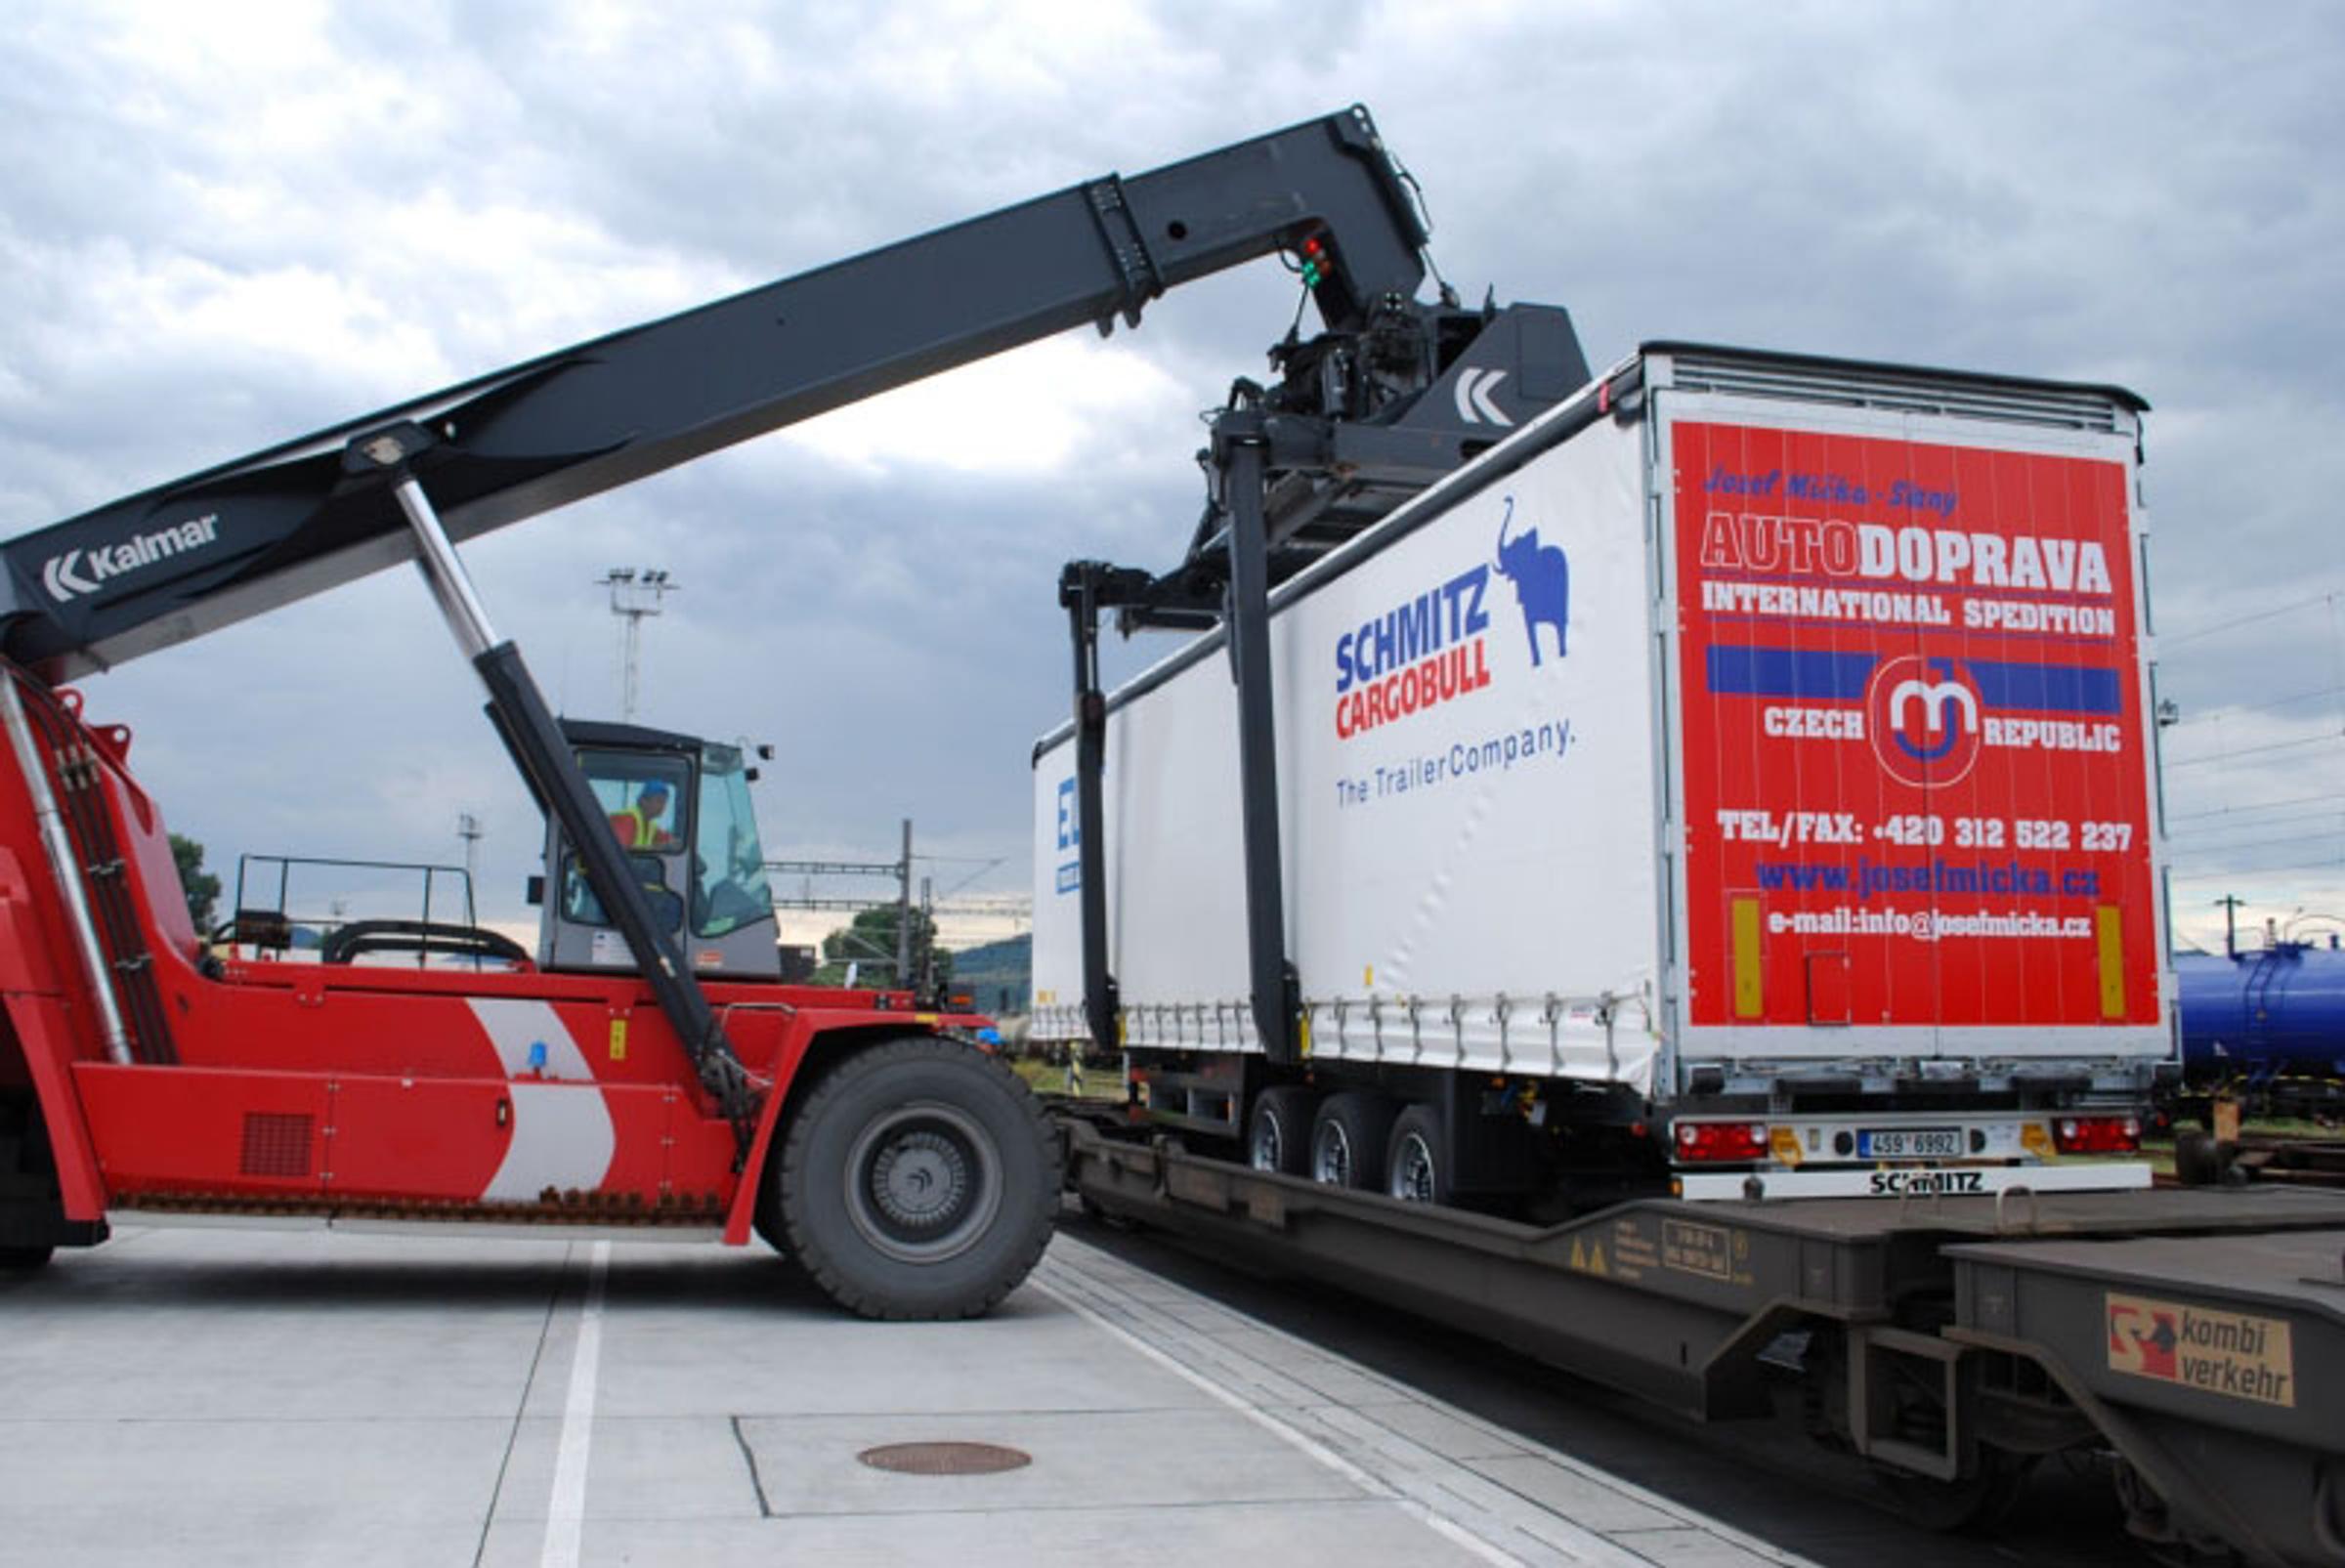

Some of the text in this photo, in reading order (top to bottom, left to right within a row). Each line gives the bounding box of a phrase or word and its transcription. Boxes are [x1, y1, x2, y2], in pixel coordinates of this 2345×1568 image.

[88, 513, 217, 580] Kalmar
[1337, 563, 1489, 694] SCHMITZ
[1702, 581, 2115, 636] INTERNATIONAL SPEDITION
[1337, 638, 1491, 741] CARGOBULL
[1765, 706, 2121, 751] CZECH REPUBLIC
[1337, 780, 1368, 808] The
[1717, 809, 1863, 849] TEL/FAX:
[1955, 817, 2005, 848] 312
[2016, 820, 2071, 850] 522
[2081, 822, 2133, 852] 237
[2181, 1309, 2266, 1356] kombi
[2181, 1355, 2288, 1403] verkehr
